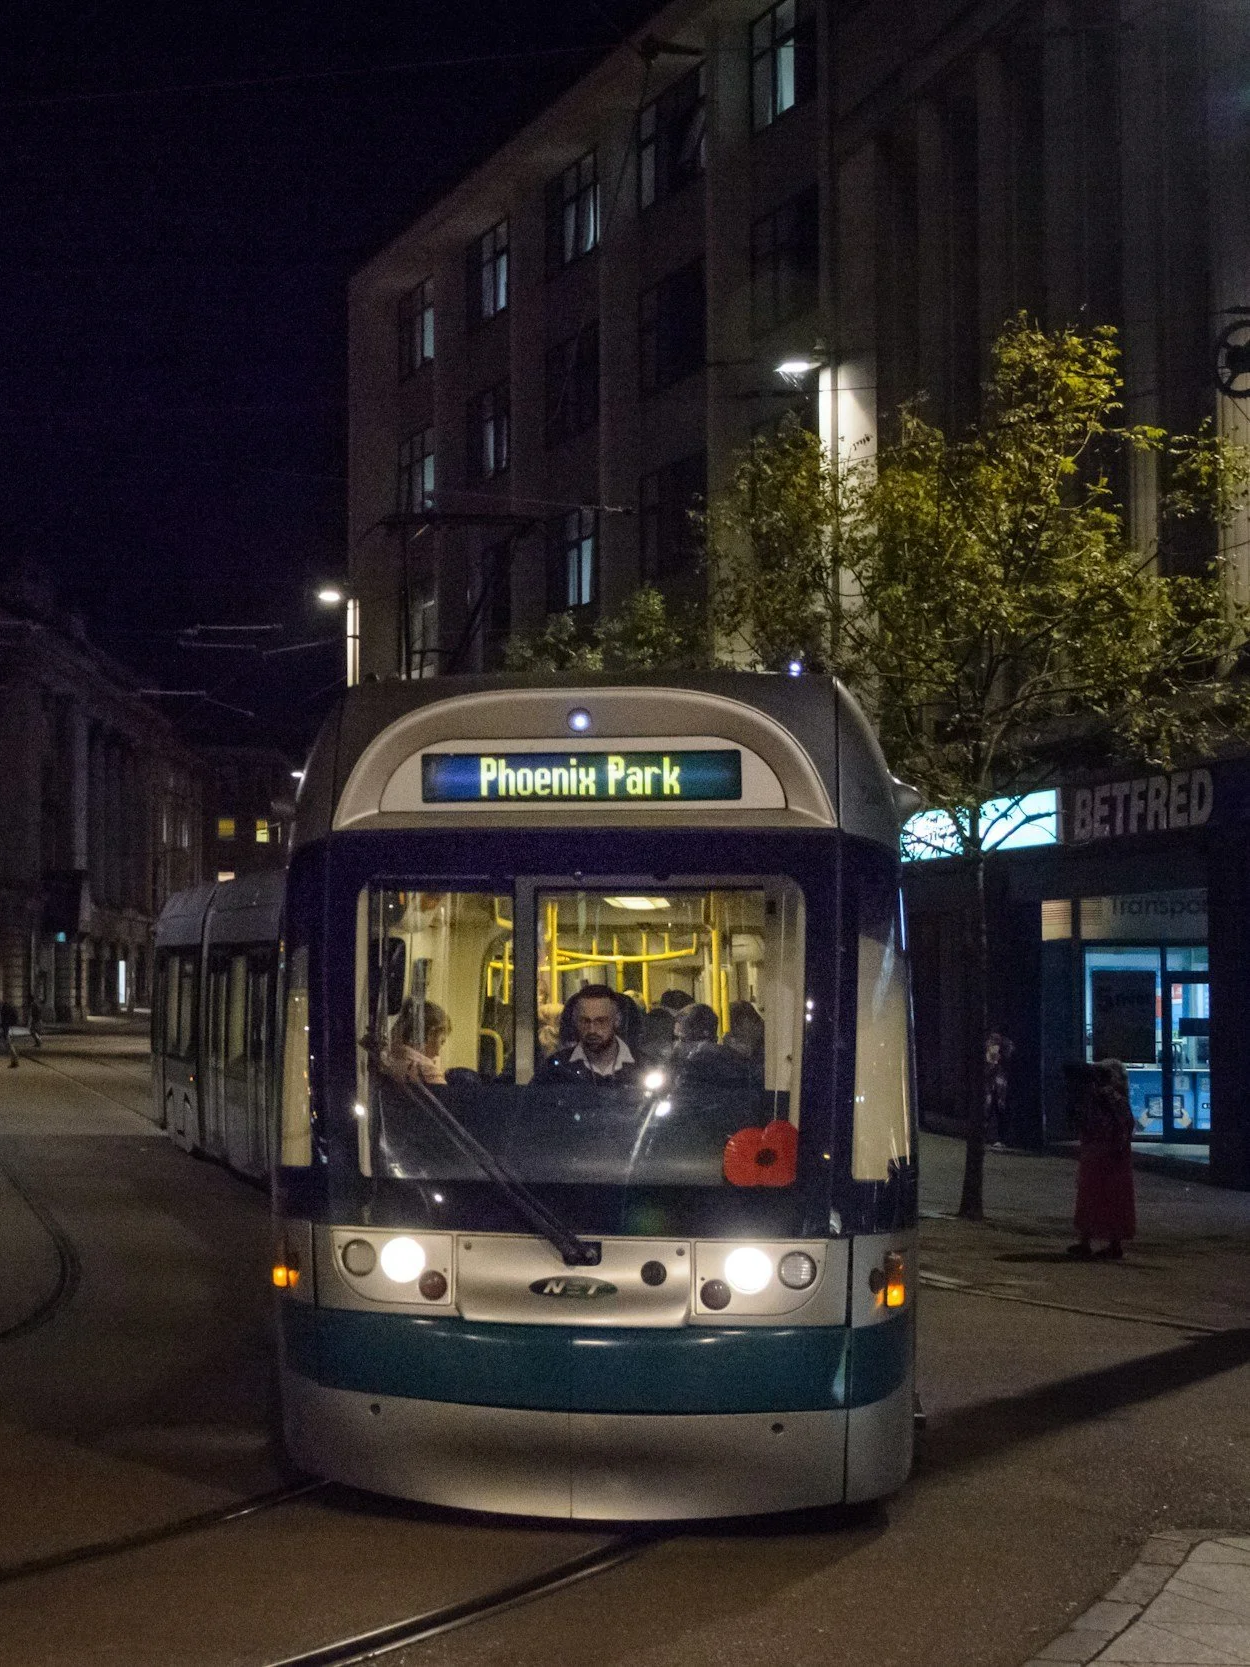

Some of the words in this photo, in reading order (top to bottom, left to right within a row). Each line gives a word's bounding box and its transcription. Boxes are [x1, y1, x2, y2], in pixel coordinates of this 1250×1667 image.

[480, 757, 596, 797] Phoenix
[608, 755, 680, 795] Park
[1074, 768, 1214, 841] BETFRED
[542, 1279, 601, 1295] NET
